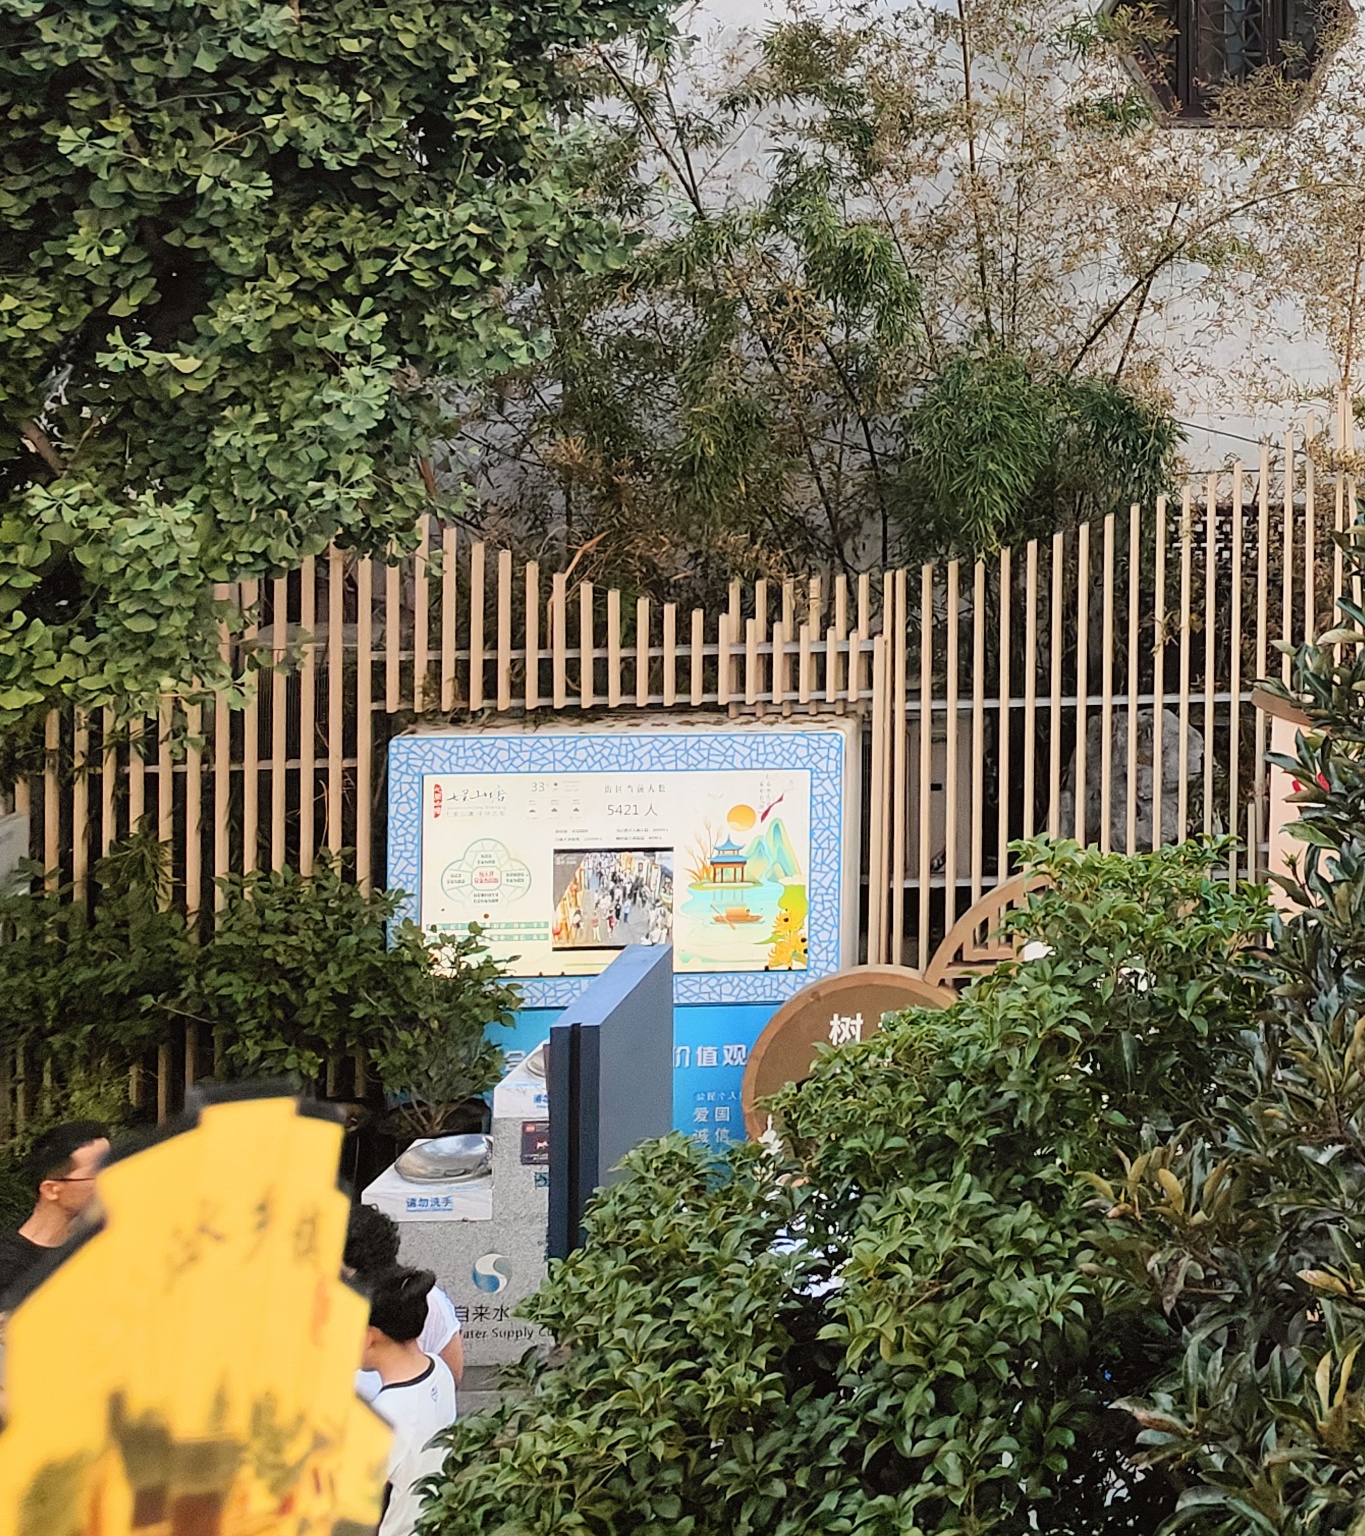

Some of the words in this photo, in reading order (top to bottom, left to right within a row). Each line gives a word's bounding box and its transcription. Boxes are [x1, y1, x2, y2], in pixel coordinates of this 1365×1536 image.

[607, 804, 639, 816] 5421
[644, 803, 658, 816] 人
[693, 1105, 731, 1123] 爱国
[405, 1196, 453, 1208] 请勿洗手
[491, 1326, 534, 1340] Supply
